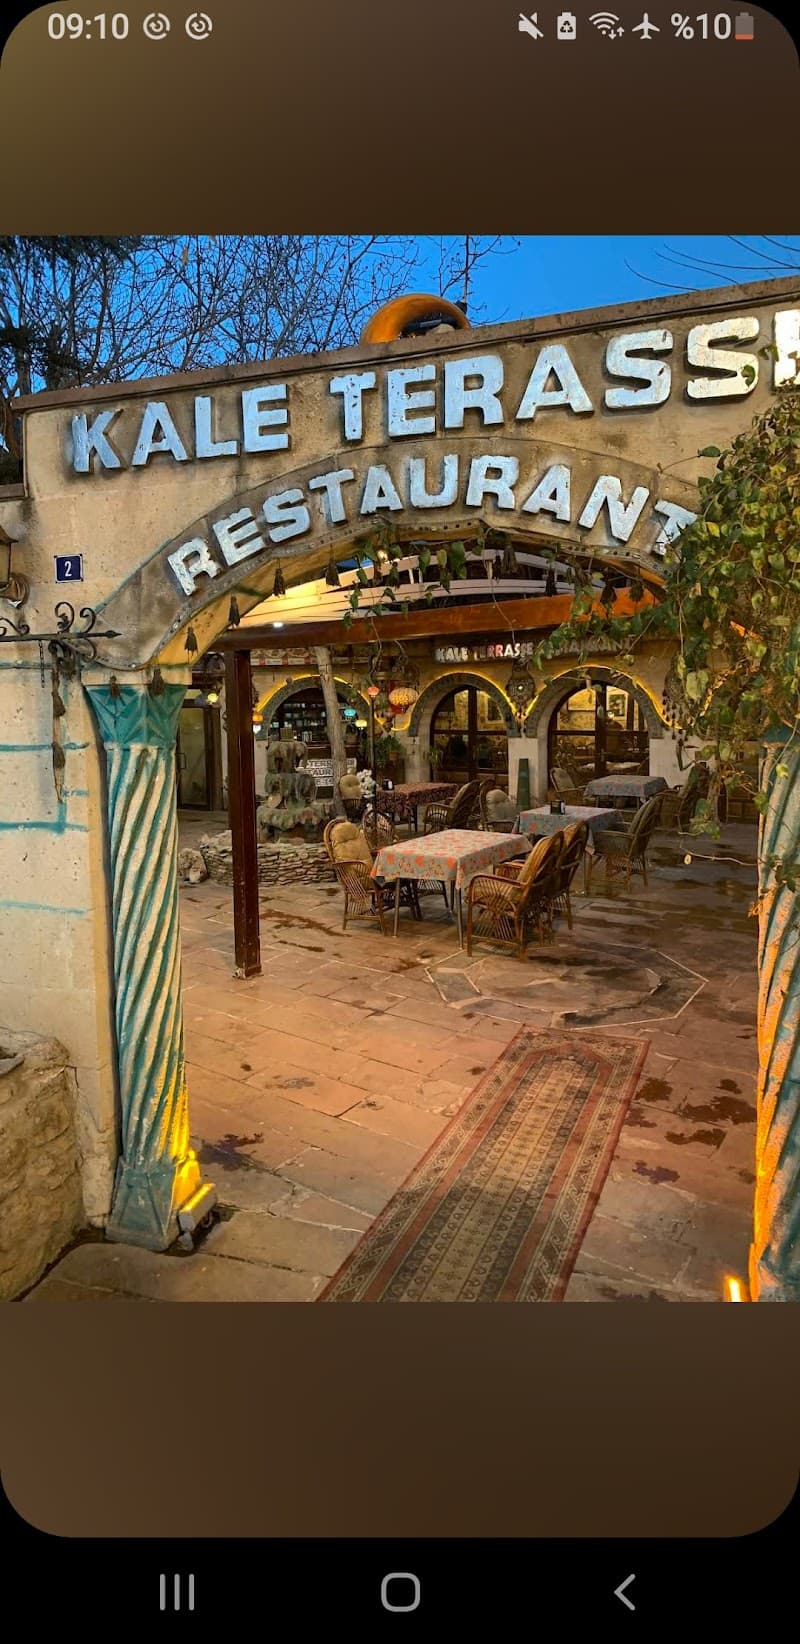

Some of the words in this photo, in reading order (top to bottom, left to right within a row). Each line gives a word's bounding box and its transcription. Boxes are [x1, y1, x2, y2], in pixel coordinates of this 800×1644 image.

[72, 383, 290, 473] KALE
[64, 560, 73, 577] 2
[167, 454, 697, 596] RESTAURANT
